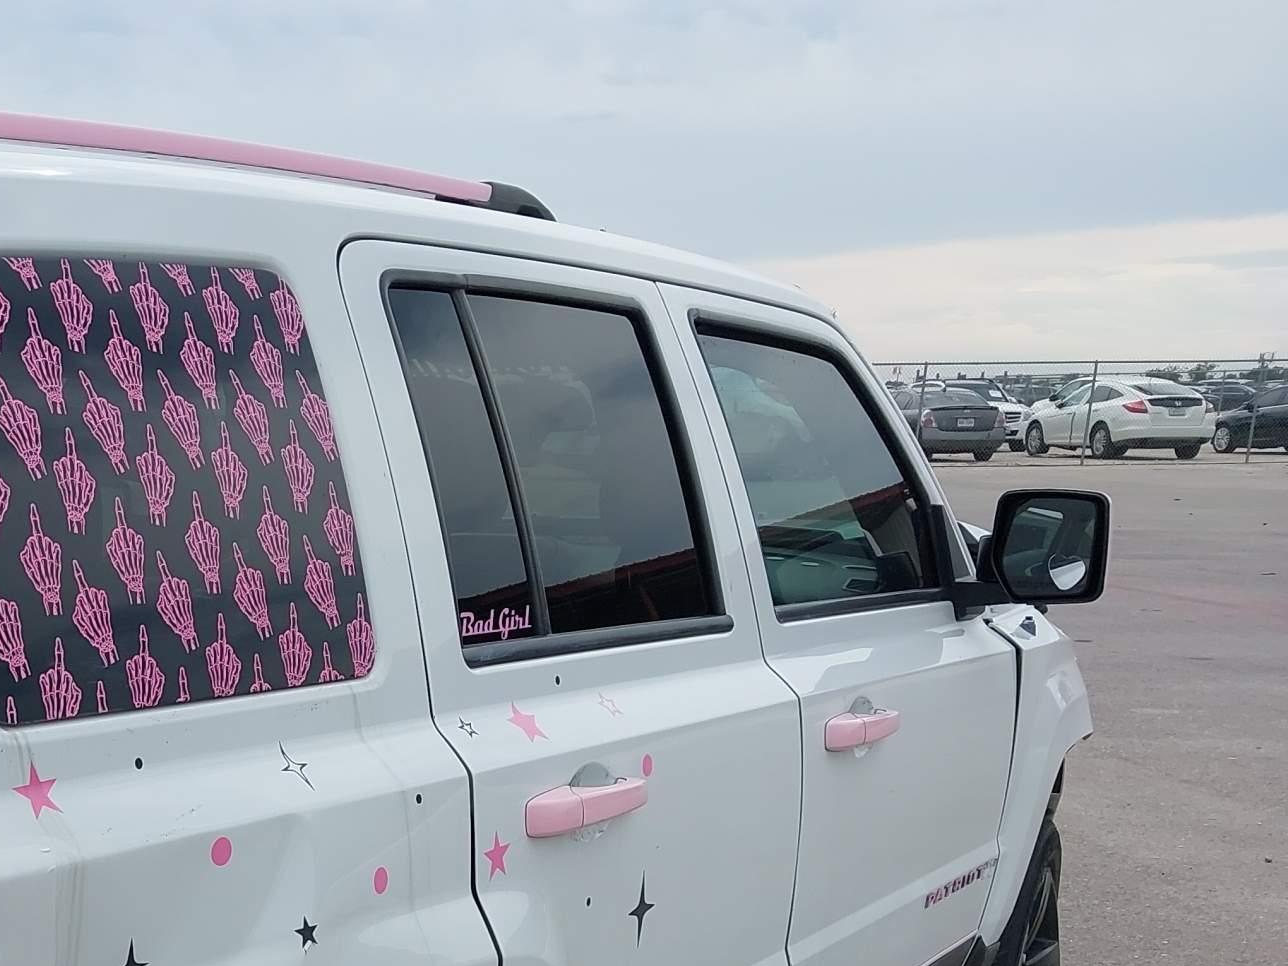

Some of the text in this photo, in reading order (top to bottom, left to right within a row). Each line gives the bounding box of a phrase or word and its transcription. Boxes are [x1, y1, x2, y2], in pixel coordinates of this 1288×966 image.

[460, 604, 532, 640] Bad Girl
[924, 864, 987, 909] PATRIOT
